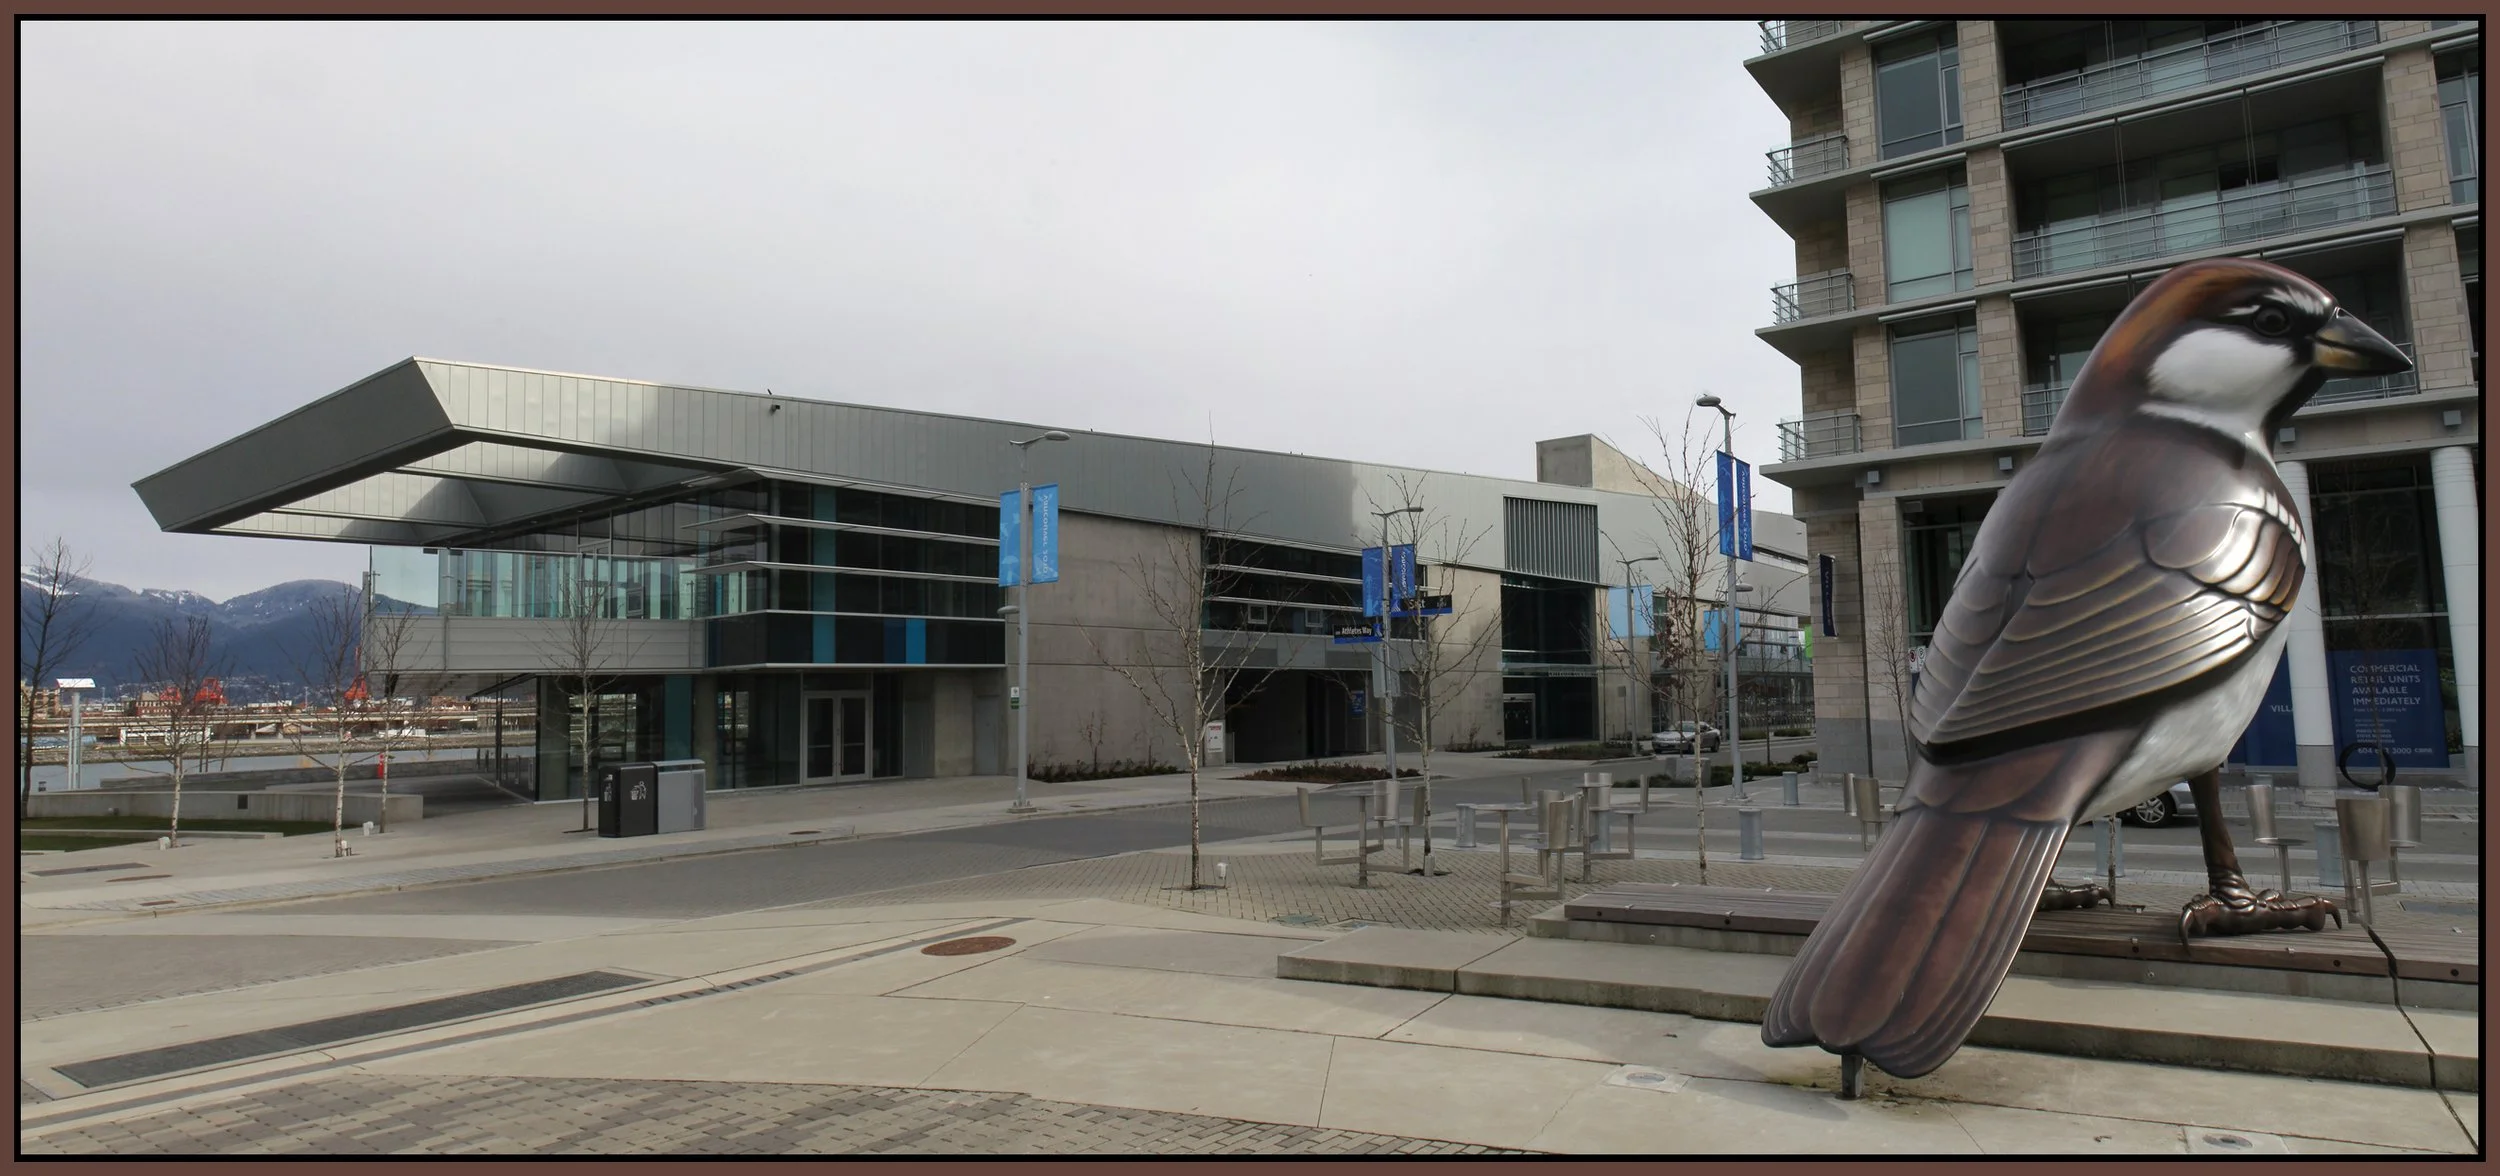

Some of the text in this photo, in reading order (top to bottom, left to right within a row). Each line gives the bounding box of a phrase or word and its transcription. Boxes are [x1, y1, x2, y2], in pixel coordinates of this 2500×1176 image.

[1342, 625, 1362, 635] Athletes
[1362, 625, 1372, 636] Way
[2350, 675, 2421, 684] RETAIL UNITS
[2352, 686, 2408, 694] AVALABLE
